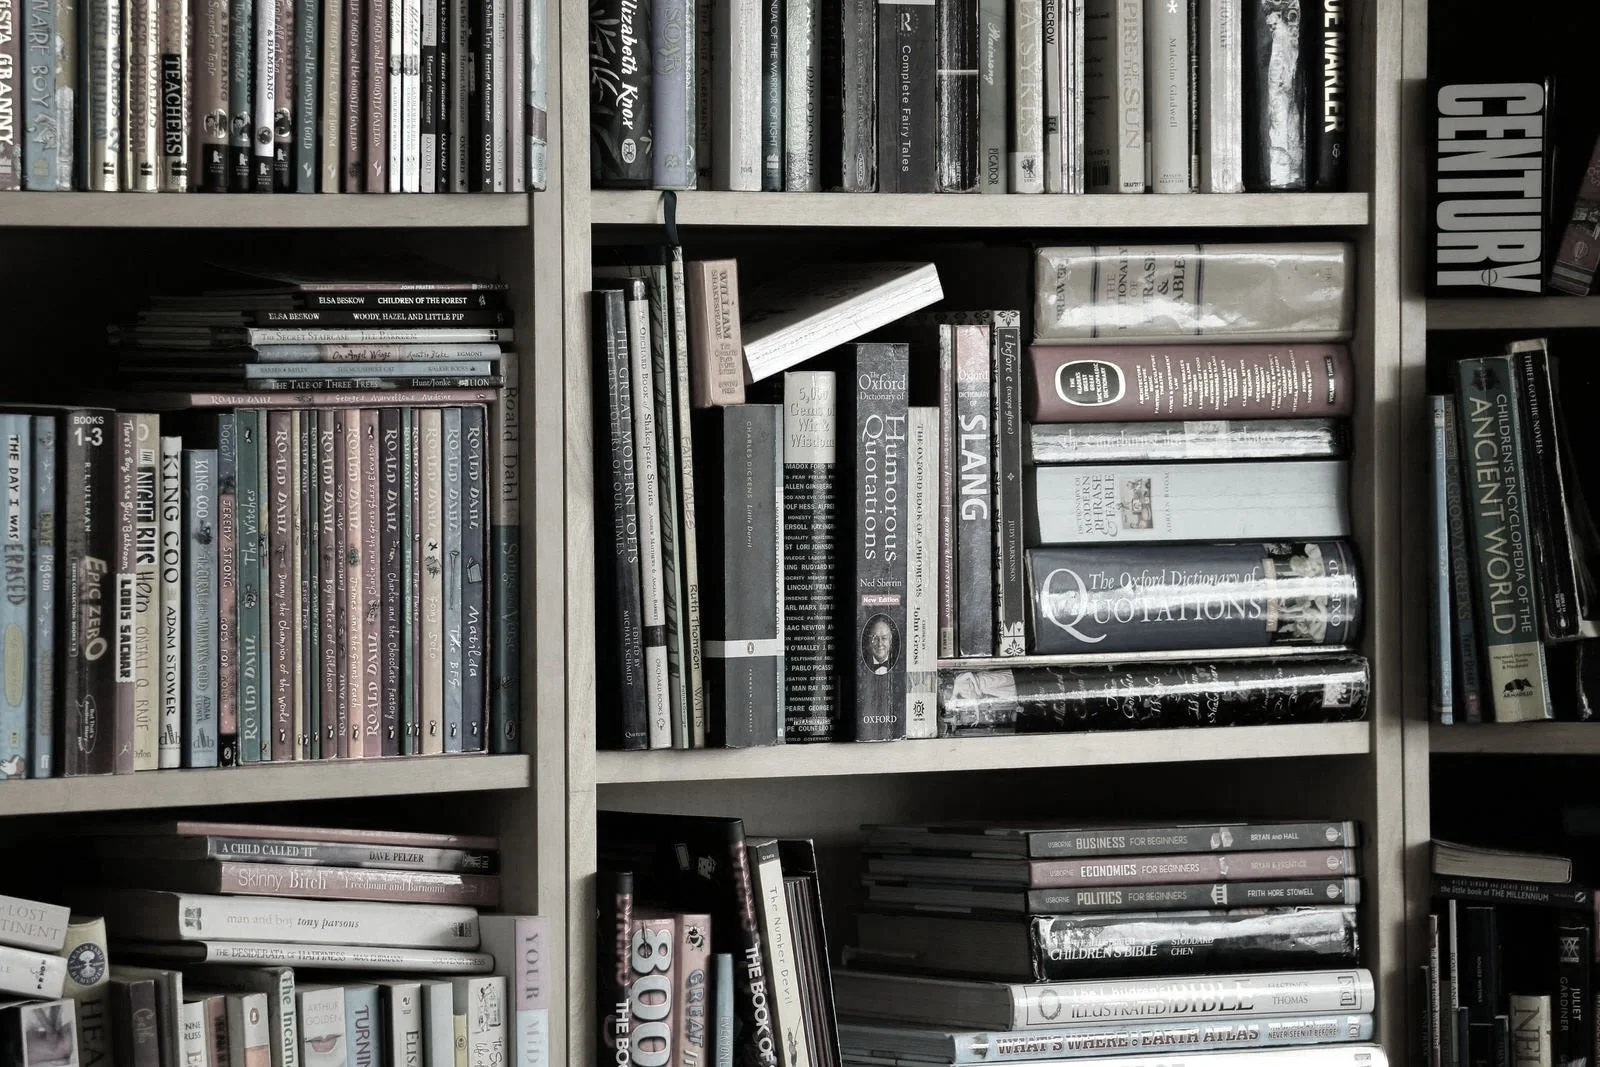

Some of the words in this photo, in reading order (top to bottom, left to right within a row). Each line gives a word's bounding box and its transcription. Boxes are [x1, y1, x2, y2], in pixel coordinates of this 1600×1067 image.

[266, 39, 274, 100] BAMBANG
[425, 55, 433, 82] Harriet
[484, 53, 493, 80] Harriet
[982, 22, 1001, 87] Plainsong
[1131, 62, 1141, 80] OF
[1168, 38, 1178, 81] Malcolm
[898, 44, 912, 104] Complete
[1019, 42, 1037, 138] SYKES
[165, 56, 183, 155] TEACHERS
[425, 84, 433, 124] Muncaster
[484, 82, 493, 122] Muncaster
[615, 82, 639, 130] Knox
[1123, 87, 1141, 149] SUN
[1168, 84, 1178, 129] Gladwell
[898, 107, 912, 138] Fairy
[425, 136, 434, 174] OXFORD
[484, 133, 492, 171] OXFORD
[901, 140, 912, 173] Tales
[988, 147, 999, 186] PICADOR
[1436, 82, 1544, 293] CENTURY
[268, 312, 288, 320] ELSA
[289, 312, 320, 320] BESKOW
[318, 296, 336, 304] ELSA
[336, 296, 365, 304] BESKOW
[377, 296, 414, 304] CHILDREN
[415, 296, 425, 304] OF
[425, 296, 440, 304] THE
[441, 296, 468, 304] FOREST
[718, 271, 733, 340] WILLIAM
[616, 327, 628, 359] THE
[271, 379, 289, 390] THE
[289, 379, 310, 389] TALE
[312, 379, 323, 389] OF
[325, 379, 351, 389] THREE
[354, 379, 379, 388] TREES
[858, 373, 907, 391] Oxford
[868, 370, 880, 378] The
[1522, 354, 1533, 383] THREE
[619, 366, 632, 421] GREAT
[859, 391, 896, 404] Dictionary
[896, 391, 905, 402] of
[1526, 384, 1538, 418] GOTHIC
[73, 416, 104, 425] BOOKS
[74, 427, 103, 446] 1-3
[1495, 393, 1515, 474] CHILDREN'S
[1531, 419, 1545, 455] NOVELS
[8, 434, 20, 461] THE
[384, 428, 398, 484] ROALD
[467, 426, 480, 481] ROALD
[1469, 395, 1505, 522] ANCIENT
[8, 467, 20, 493] DAY
[162, 450, 180, 522] KING
[621, 430, 636, 505] MODERN
[959, 413, 988, 521] SLANG
[8, 497, 20, 507] I
[862, 413, 885, 560] Quotations
[884, 413, 907, 564] Humorous
[1081, 473, 1093, 536] MODERN
[1092, 473, 1104, 532] PHRASE
[1105, 472, 1116, 517] FABLE
[8, 514, 20, 540] WAS
[222, 499, 233, 541] JEREMY
[241, 489, 257, 535] Witches
[385, 489, 398, 533] DAHL
[468, 487, 480, 530] DAHL
[625, 512, 639, 565] POETS
[1007, 519, 1017, 540] JUDY
[1504, 476, 1526, 582] ENCYCLOPEDIA
[163, 531, 180, 585] COO
[222, 546, 233, 588] STRONG
[241, 541, 257, 567] The
[1007, 540, 1017, 582] PARKINSON
[3, 543, 26, 605] ERASED
[859, 578, 875, 588] Ned
[877, 578, 903, 588] Sherrin
[1088, 570, 1114, 590] The
[1118, 568, 1166, 592] Oxford
[1169, 567, 1241, 589] Dictionary
[1242, 566, 1260, 583] of
[1482, 525, 1517, 636] WORLD
[119, 578, 132, 621] LOUIS
[688, 583, 699, 616] Ruth
[878, 596, 901, 604] Edition
[1040, 567, 1262, 643] QUOTATIONS
[1516, 583, 1530, 606] OF
[165, 607, 177, 650] ADAM
[622, 609, 632, 647] MICHAEL
[1520, 607, 1532, 633] THE
[119, 624, 132, 678] SACHAR
[467, 605, 481, 678] Matilda
[691, 617, 701, 670] Thomson
[165, 655, 177, 715] STOWER
[624, 648, 634, 686] SCHMIDT
[369, 851, 390, 862] DAVE
[392, 851, 424, 863] PELZER
[1047, 841, 1074, 849] USBORNE
[1075, 836, 1126, 850] BUSINESS
[1129, 837, 1147, 847] FOR
[1147, 835, 1189, 846] BEGINNERS
[237, 867, 282, 891] Skinny
[288, 869, 327, 890] Bitch
[1080, 864, 1137, 878] ECONOMICS
[1141, 865, 1159, 874] FOR
[1159, 863, 1200, 873] BEGINNERS
[768, 885, 780, 912] The
[1045, 896, 1071, 904] USBORNE
[1077, 891, 1123, 905] POLITICS
[1128, 893, 1145, 902] FOR
[1145, 891, 1188, 901] BEGINNERS
[1247, 889, 1266, 897] FRITH
[1267, 889, 1284, 897] HORE
[1286, 888, 1315, 896] STOWELL
[1440, 885, 1451, 894] the
[1466, 887, 1483, 896] book
[1491, 888, 1505, 898] THE
[1506, 890, 1549, 902] MILLENNIUM
[8, 904, 47, 922] LOST
[297, 917, 318, 930] tony
[321, 918, 360, 930] parsons
[214, 948, 229, 957] THE
[231, 947, 285, 960] DESIDERATA
[297, 950, 346, 962] HAPPINESS
[771, 917, 786, 964] Number
[1050, 946, 1122, 961] CHILDREN'S
[1124, 944, 1159, 958] BIBLE
[37, 959, 48, 990] PRION
[745, 942, 763, 979] THE
[780, 968, 792, 1005] Devil
[1559, 976, 1570, 1033] GARDINER
[1569, 987, 1584, 1022] JULIET
[305, 1014, 343, 1026] GOLDEN
[307, 1000, 339, 1012] ARTHUR
[686, 968, 705, 1049] GREAT
[749, 981, 769, 1036] BOOK
[756, 1036, 773, 1062] OF
